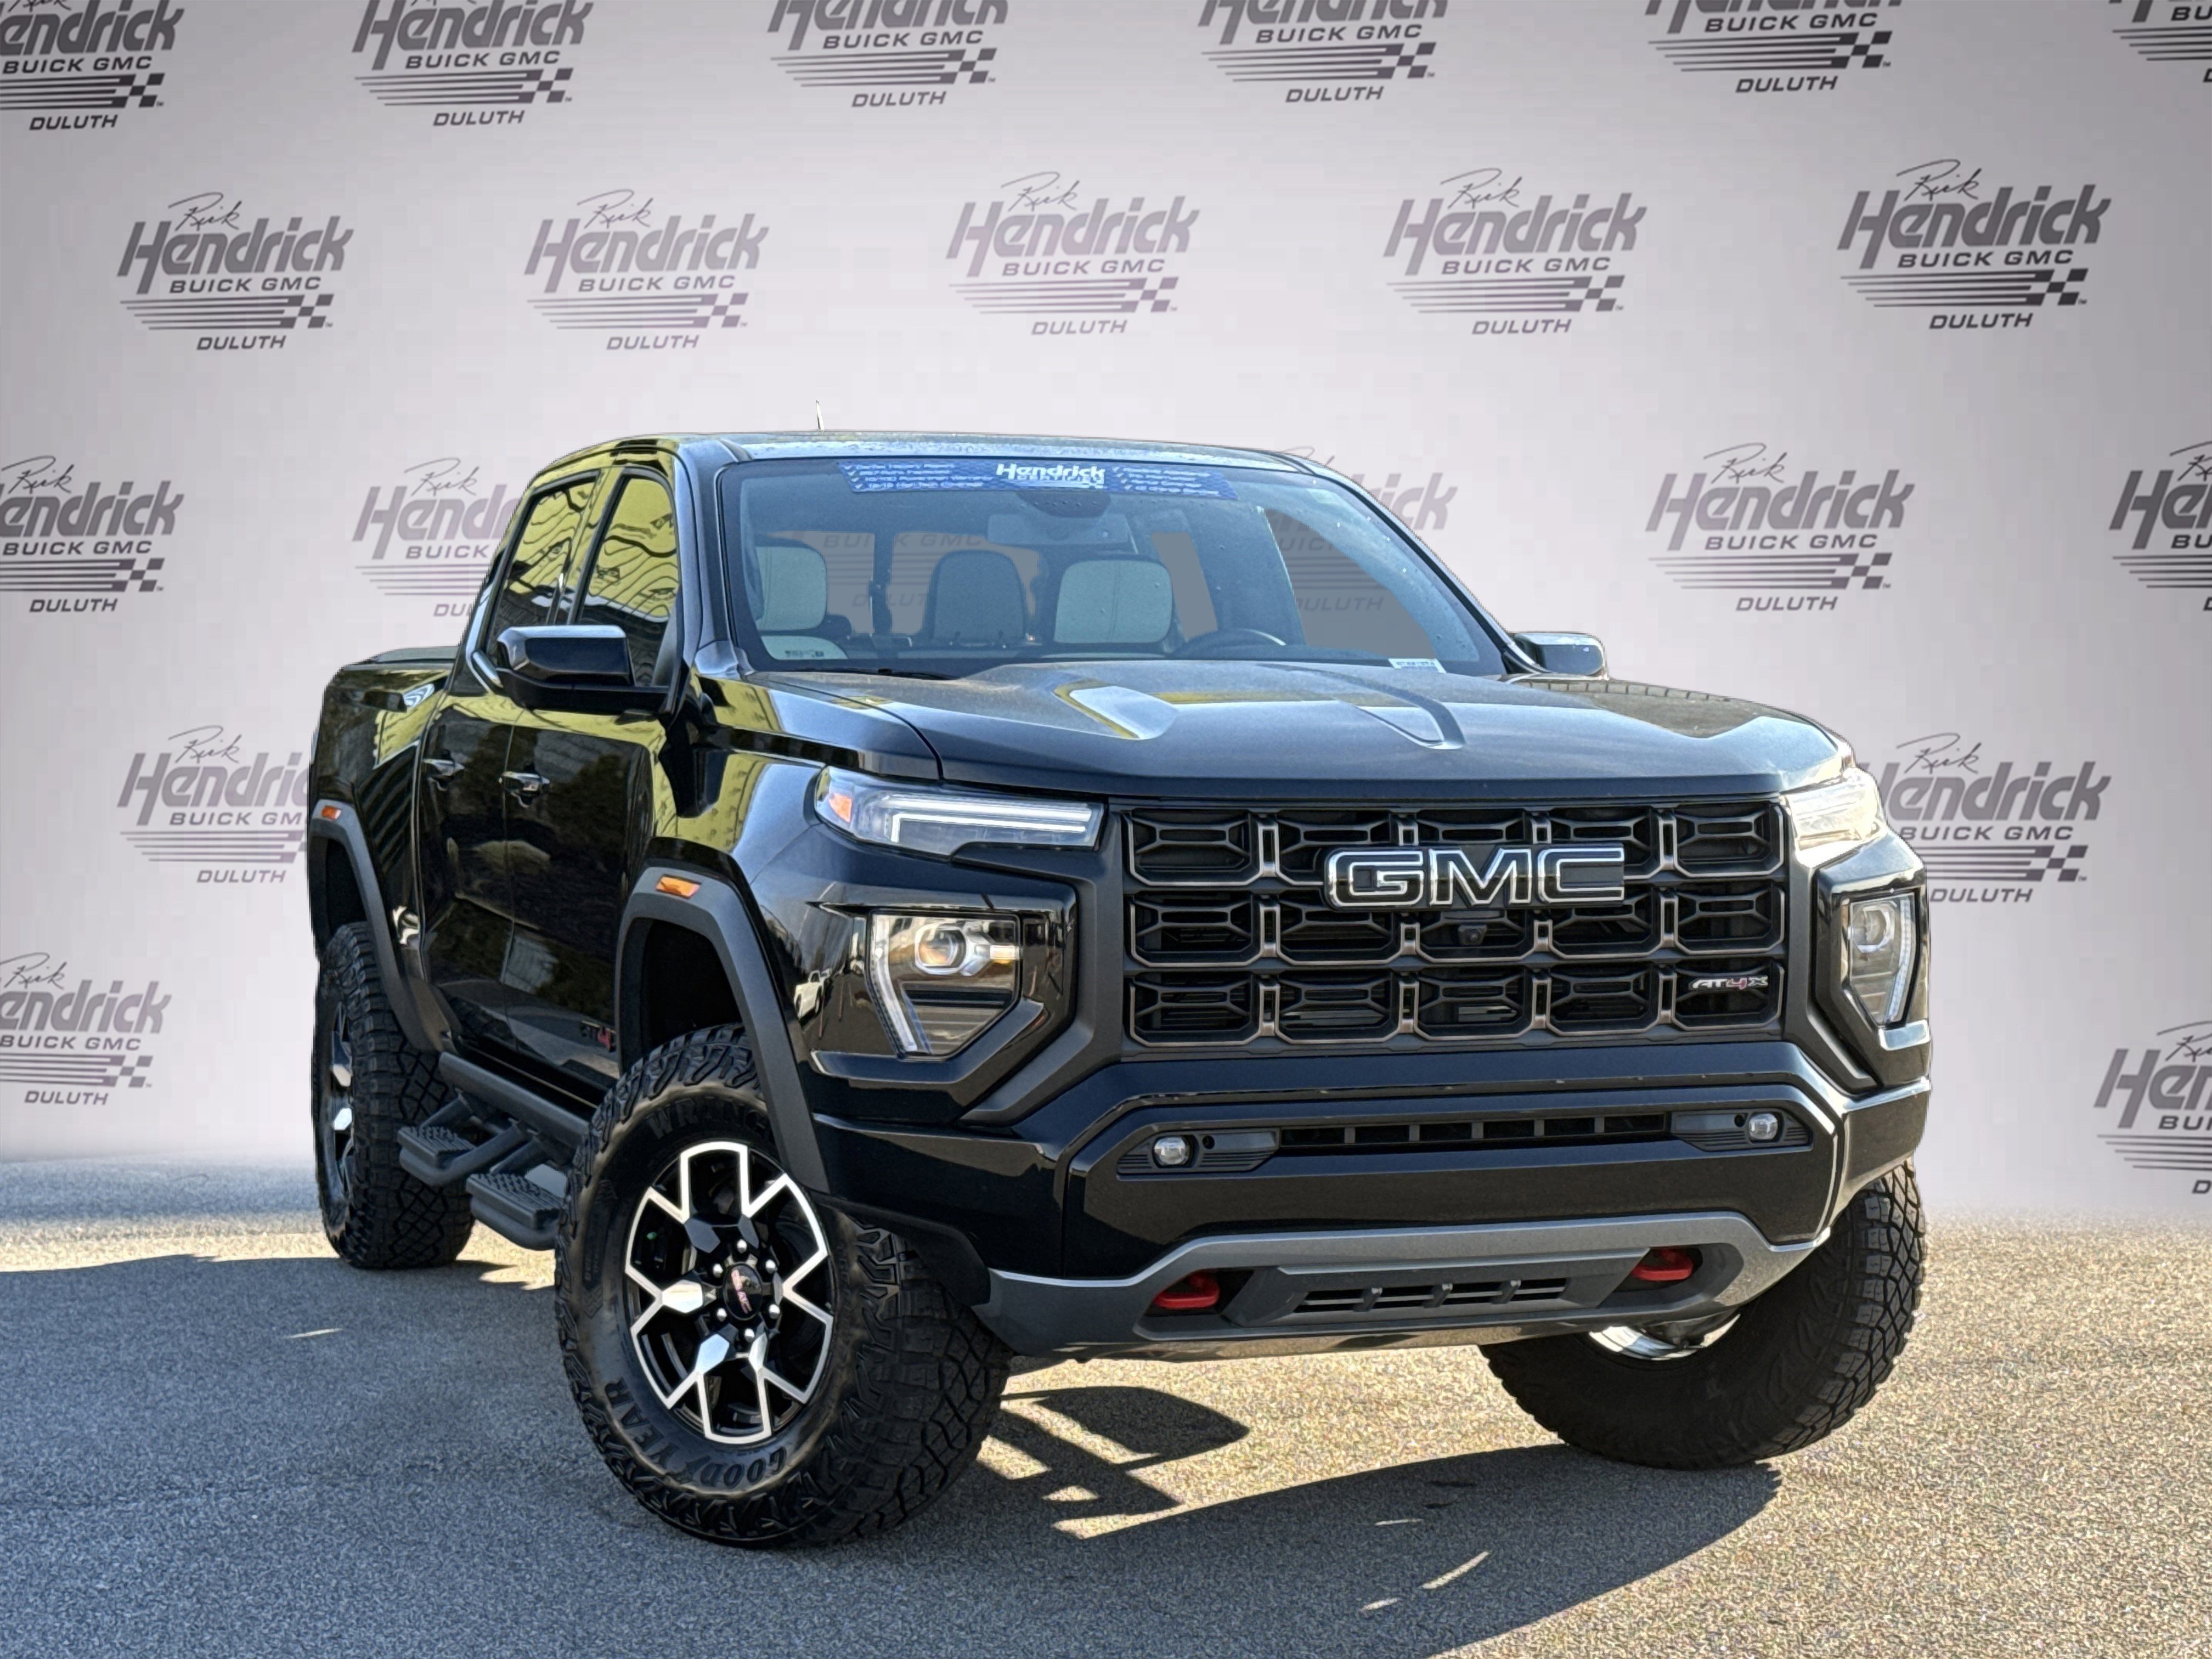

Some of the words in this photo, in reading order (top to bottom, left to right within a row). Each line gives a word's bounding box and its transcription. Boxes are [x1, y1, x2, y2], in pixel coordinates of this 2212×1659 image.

[0, 0, 184, 55] endrick
[1705, 15, 1800, 33] BUICK
[1809, 13, 1878, 29] GMC
[352, 0, 594, 70] Hendrick
[823, 32, 911, 49] BUICK
[920, 30, 984, 46] GMC
[1256, 27, 1346, 44] BUICK
[1357, 24, 1423, 40] GMC
[3, 58, 84, 74] BUICK
[93, 56, 152, 71] GMC
[405, 53, 490, 69] BUICK
[499, 50, 561, 65] GMC
[1735, 76, 1838, 93] DULUTH
[851, 91, 946, 108] DULUTH
[1285, 86, 1384, 103] DULUTH
[29, 115, 118, 130] DULUTH
[433, 110, 525, 126] DULUTH
[1383, 193, 1647, 276] Hendrick
[1837, 184, 2112, 269] Hendrick
[946, 196, 1200, 278] Hendrick
[117, 216, 354, 295] Hendrick
[524, 213, 769, 294] Hendrick
[1898, 251, 1994, 268] BUICK
[2004, 250, 2074, 266] GMC
[1002, 261, 1091, 276] BUICK
[1101, 259, 1165, 273] GMC
[1441, 258, 1534, 275] BUICK
[1544, 257, 1611, 272] GMC
[170, 278, 252, 294] BUICK
[261, 276, 321, 291] GMC
[578, 276, 664, 292] BUICK
[673, 275, 736, 290] GMC
[1031, 319, 1128, 335] DULUTH
[1471, 319, 1572, 335] DULUTH
[1929, 313, 2033, 330] DULUTH
[196, 335, 286, 350] DULUTH
[606, 335, 699, 350] DULUTH
[996, 463, 1106, 481] Hendrick
[0, 480, 184, 538] endrick
[1645, 470, 1915, 551] Hendrick
[352, 484, 522, 560] Hendr
[2, 541, 84, 556] BUICK
[93, 540, 152, 554] GMC
[823, 535, 910, 549] BUIK
[1277, 537, 1334, 551] UIC
[1705, 535, 1799, 550] BUICK
[1809, 534, 1878, 549] GMC
[406, 545, 490, 559] BUICK
[29, 598, 118, 613] DULUTH
[1736, 596, 1838, 611] DULUTH
[117, 752, 307, 826] Hendri
[169, 812, 252, 826] BUICK
[261, 812, 306, 826] GM
[1901, 826, 1994, 840] BUICK
[2004, 826, 2074, 840] GMC
[196, 870, 286, 883] DULUTH
[1328, 847, 1624, 907] GMC
[1930, 888, 2033, 903] DULUTH
[1691, 975, 1769, 990] AT4X
[0, 979, 172, 1034] endrick
[0, 1035, 77, 1049] BUICK
[85, 1037, 142, 1051] GMC
[24, 1091, 109, 1105] DULUTH
[2158, 1115, 2212, 1131] BUI
